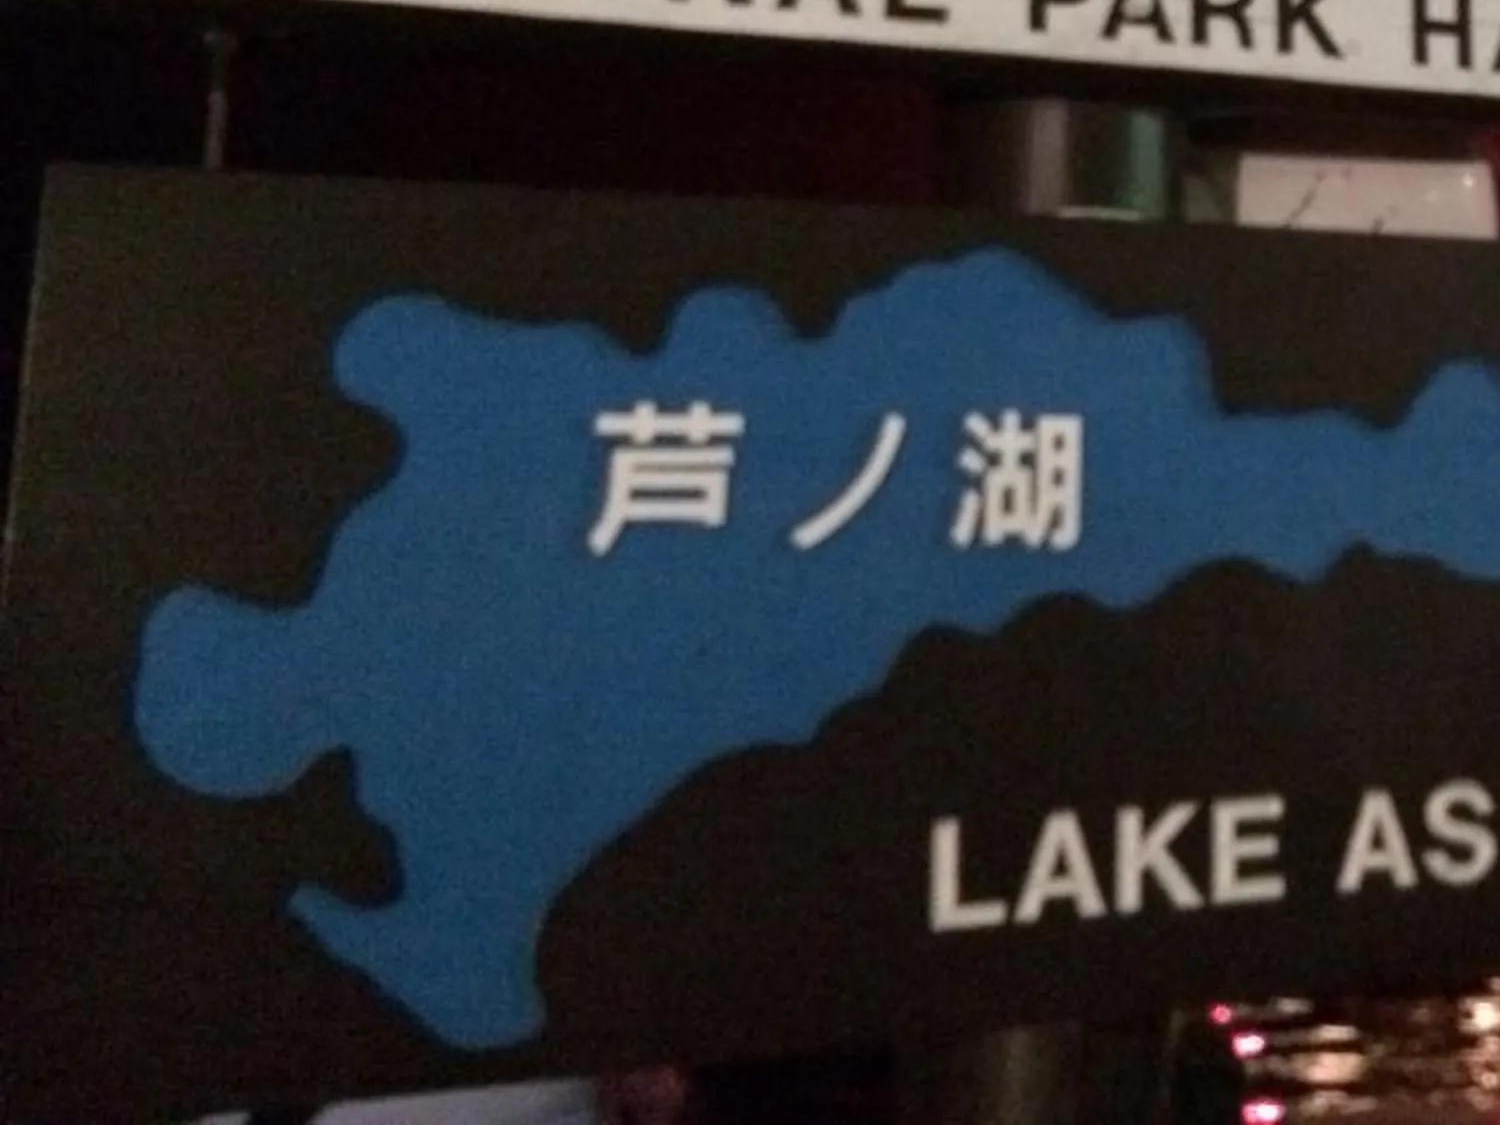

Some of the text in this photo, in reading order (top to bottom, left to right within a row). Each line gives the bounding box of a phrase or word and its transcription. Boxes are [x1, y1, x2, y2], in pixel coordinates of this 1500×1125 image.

[587, 400, 1084, 556] 芦ノ湖
[928, 794, 1287, 933] LAKE
